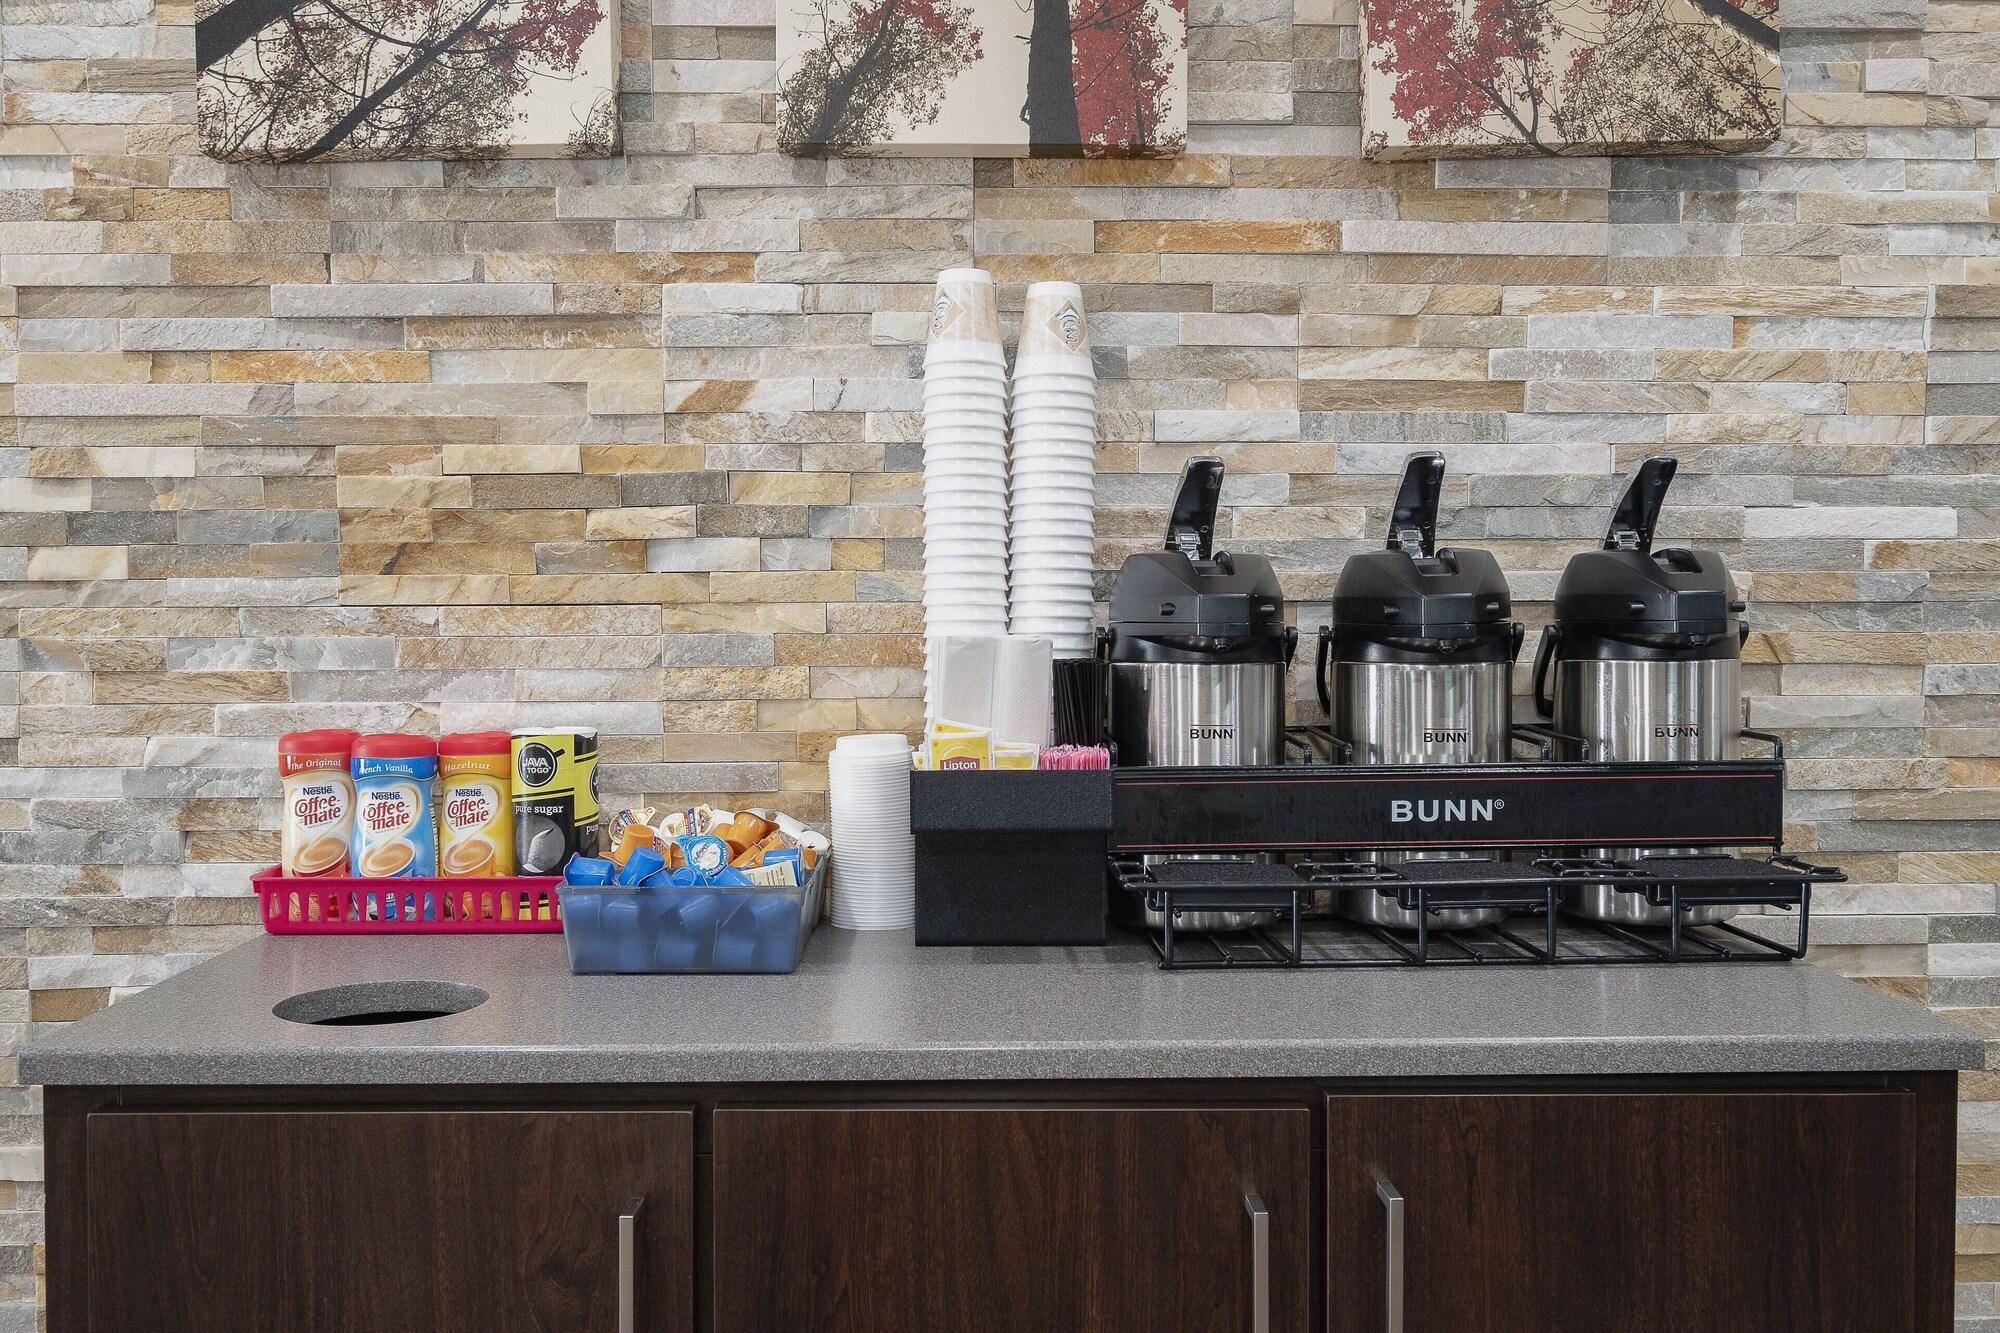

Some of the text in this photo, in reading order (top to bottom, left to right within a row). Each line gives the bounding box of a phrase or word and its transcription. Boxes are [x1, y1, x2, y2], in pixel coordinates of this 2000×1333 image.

[1190, 728, 1233, 739] BUNN
[1423, 732, 1467, 743] BUNN
[1654, 727, 1699, 738] BUNN
[305, 759, 342, 768] Original
[444, 761, 490, 772] Hazelnut
[522, 757, 550, 768] JAVA
[943, 760, 977, 771] Lipton
[385, 763, 414, 774] Vanilla
[515, 804, 564, 815] pure sugar
[304, 806, 341, 826] mate
[372, 812, 410, 831] mate
[455, 809, 489, 828] mate
